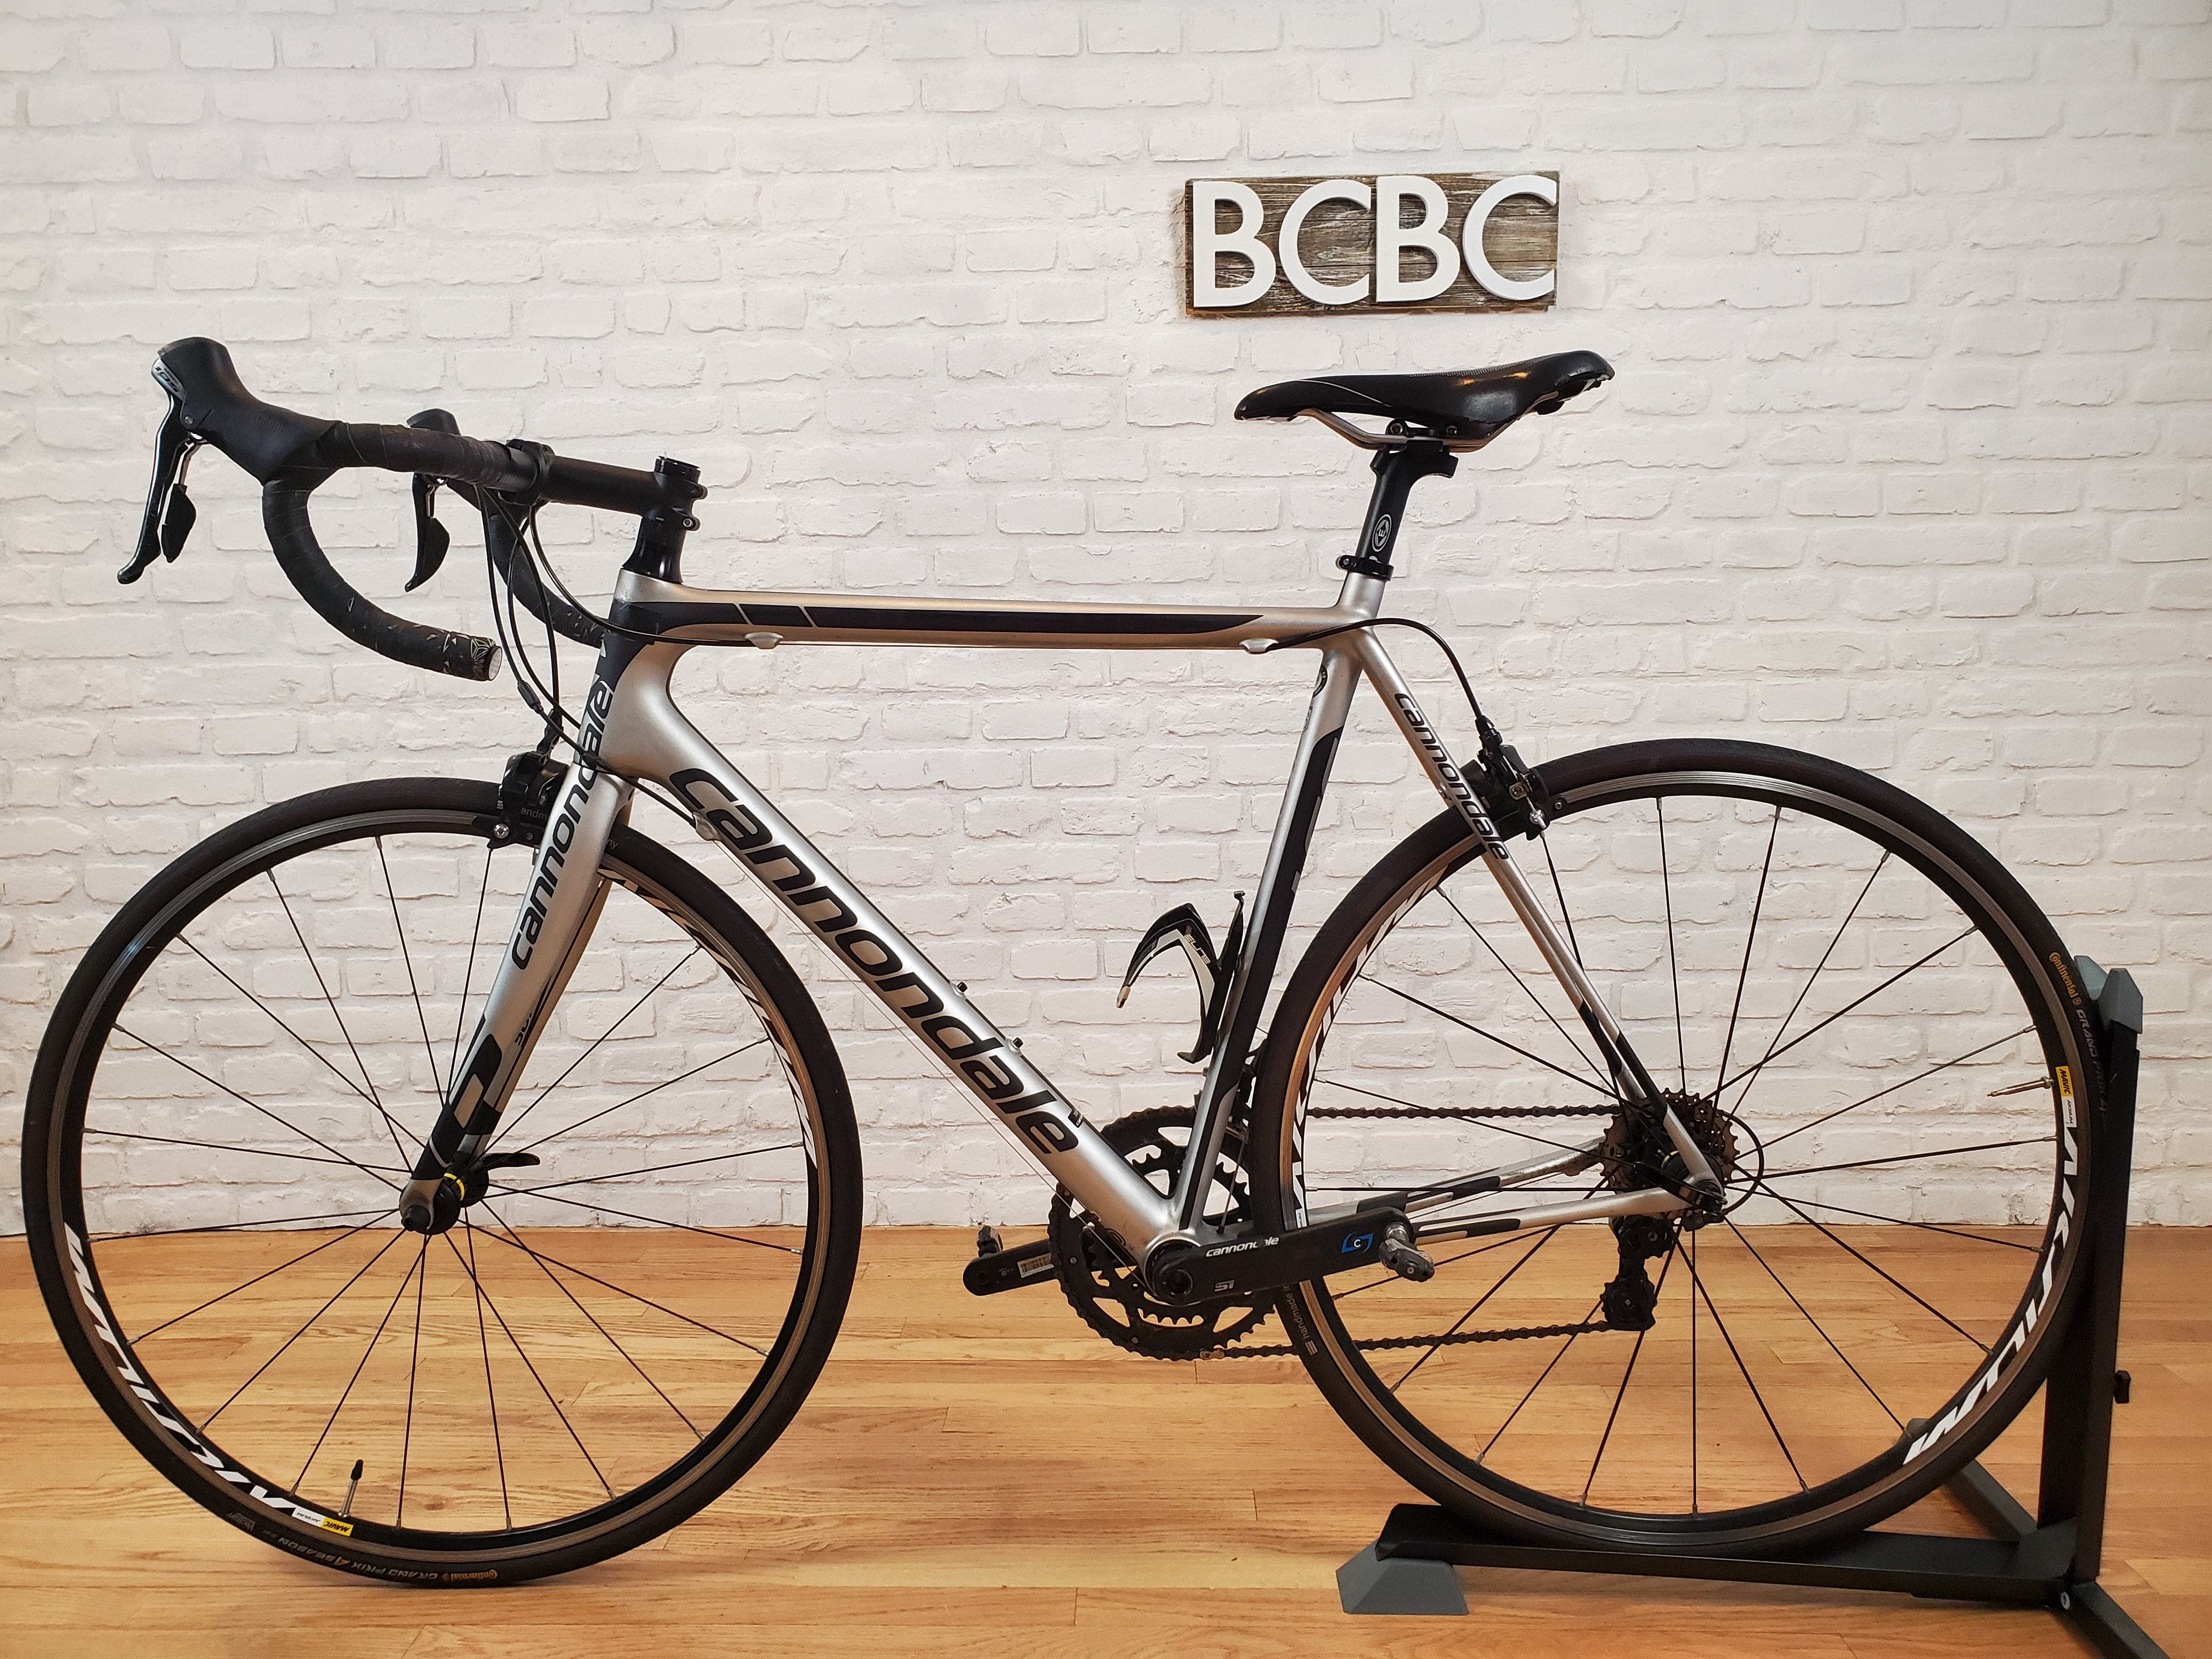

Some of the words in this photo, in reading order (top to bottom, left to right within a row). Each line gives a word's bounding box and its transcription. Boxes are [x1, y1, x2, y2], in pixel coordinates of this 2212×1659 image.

[1193, 175, 1557, 307] BCBC
[1394, 693, 1509, 860] cannondale
[512, 681, 613, 970] cannondale
[669, 768, 1079, 1154] cannondale
[1184, 934, 1211, 964] ELITE
[2049, 952, 2079, 1000] Continental
[2076, 1008, 2098, 1058] GRAND
[2059, 1069, 2071, 1094] MAVIC
[1206, 1236, 1279, 1257] cannonle
[1286, 1293, 1310, 1341] handmade
[323, 1521, 350, 1533] MAVIC
[352, 1561, 386, 1573] PRIX
[388, 1568, 438, 1579] GRAND
[450, 1569, 498, 1581] Continental
